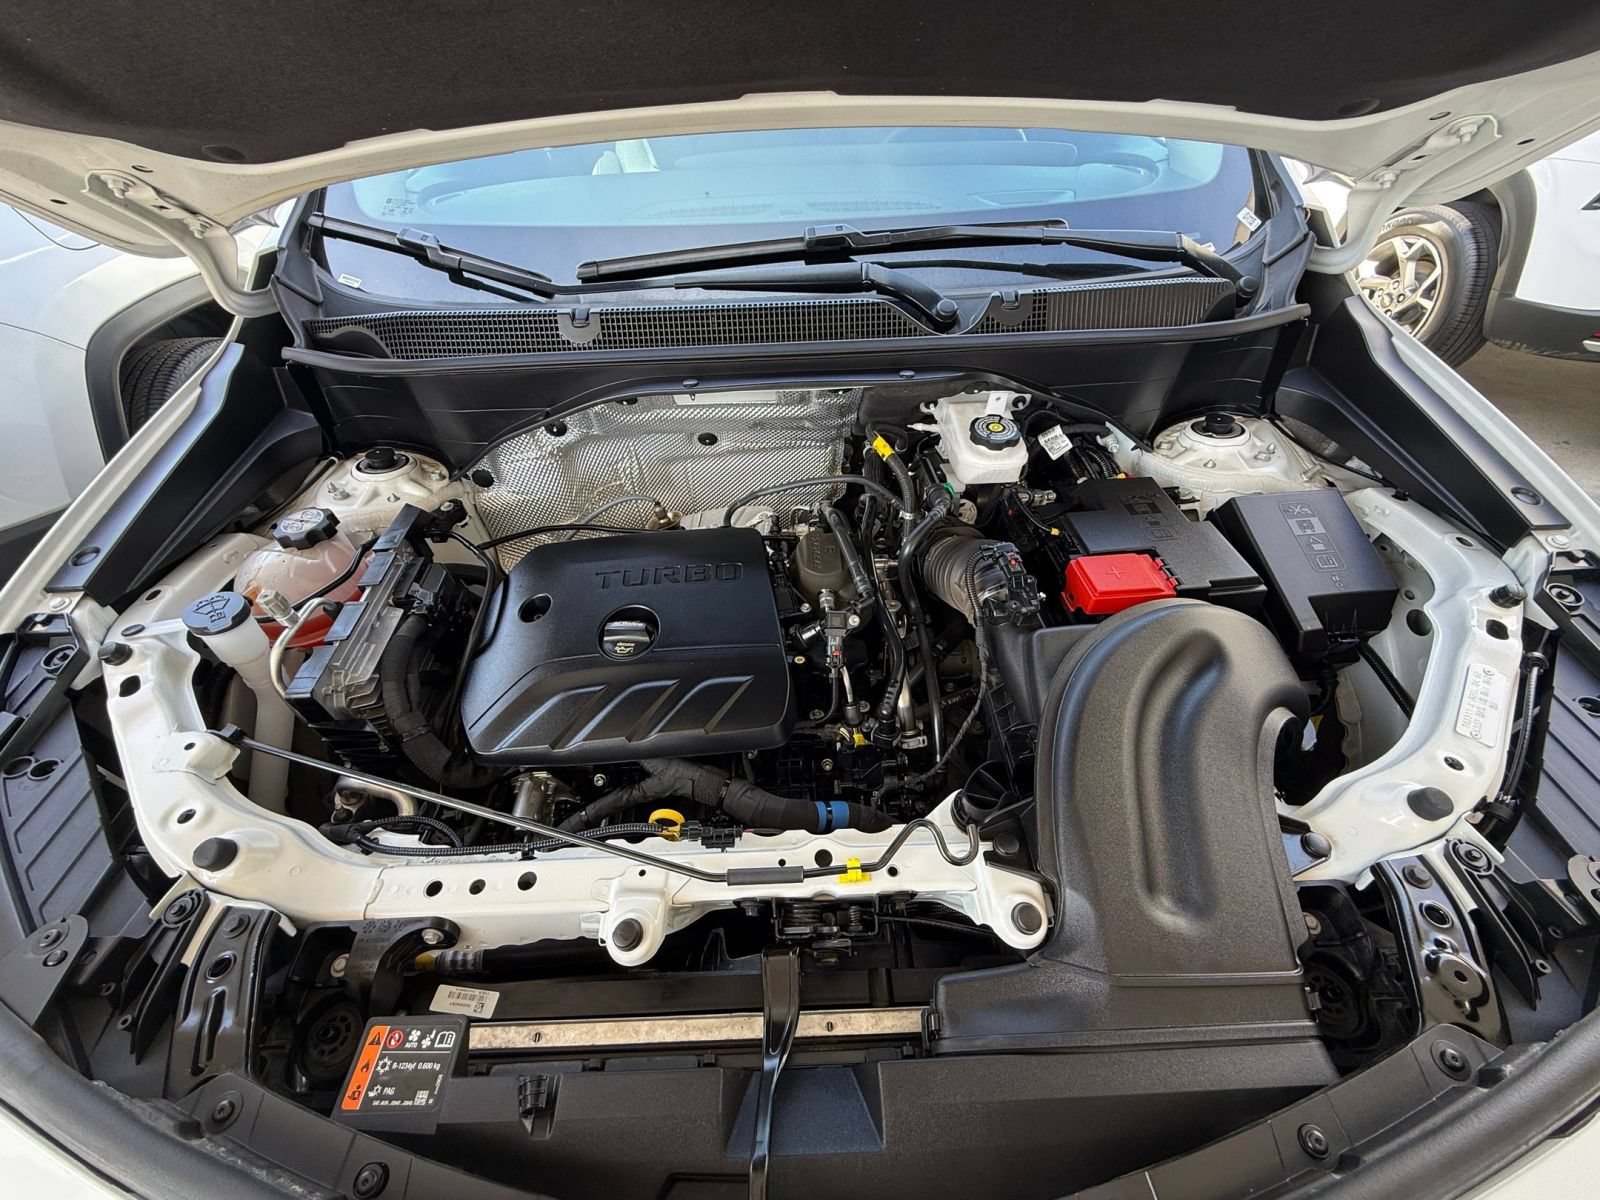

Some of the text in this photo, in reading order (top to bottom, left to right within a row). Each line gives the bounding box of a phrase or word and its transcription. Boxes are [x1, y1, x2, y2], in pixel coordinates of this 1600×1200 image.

[595, 561, 744, 589] TURBO
[433, 1062, 441, 1071] kg
[383, 1087, 396, 1095] PAG
